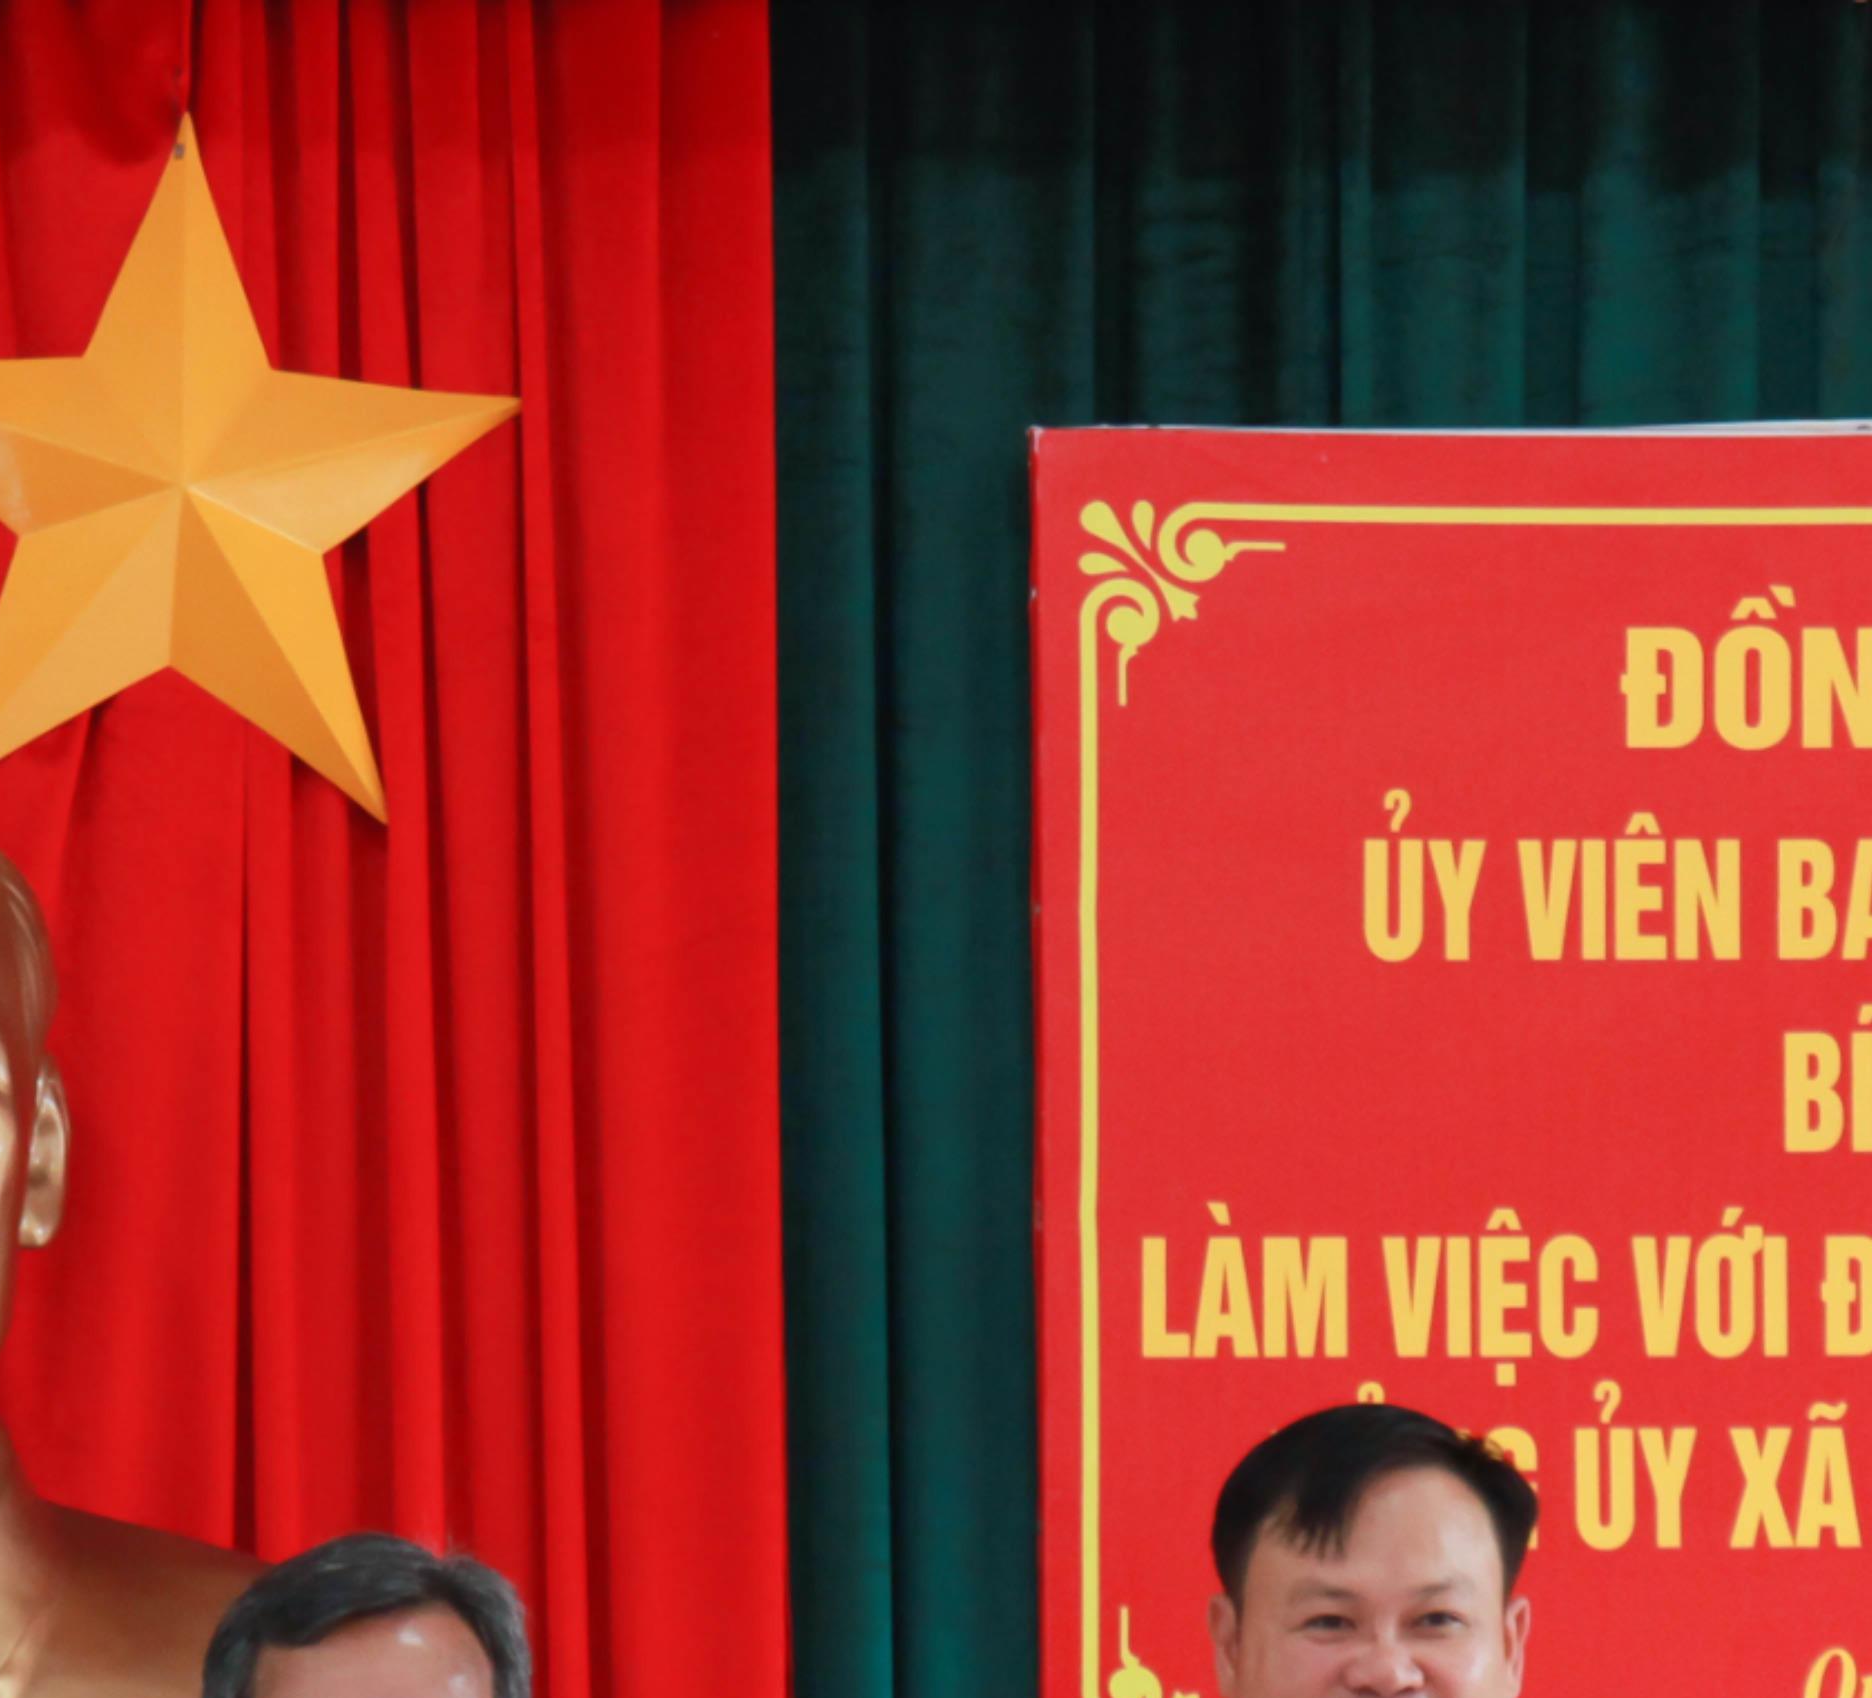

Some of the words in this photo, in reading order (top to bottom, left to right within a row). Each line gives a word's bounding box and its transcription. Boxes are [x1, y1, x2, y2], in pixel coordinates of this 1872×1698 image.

[1364, 787, 1485, 963] ỦY
[1518, 812, 1740, 961] VIÊN
[1141, 1202, 1348, 1358] LÀM
[1382, 1208, 1599, 1386] VIỆC
[1631, 1206, 1788, 1358] VỚI
[1574, 1380, 1697, 1551] ỦY
[1729, 1402, 1861, 1549] XÃ
